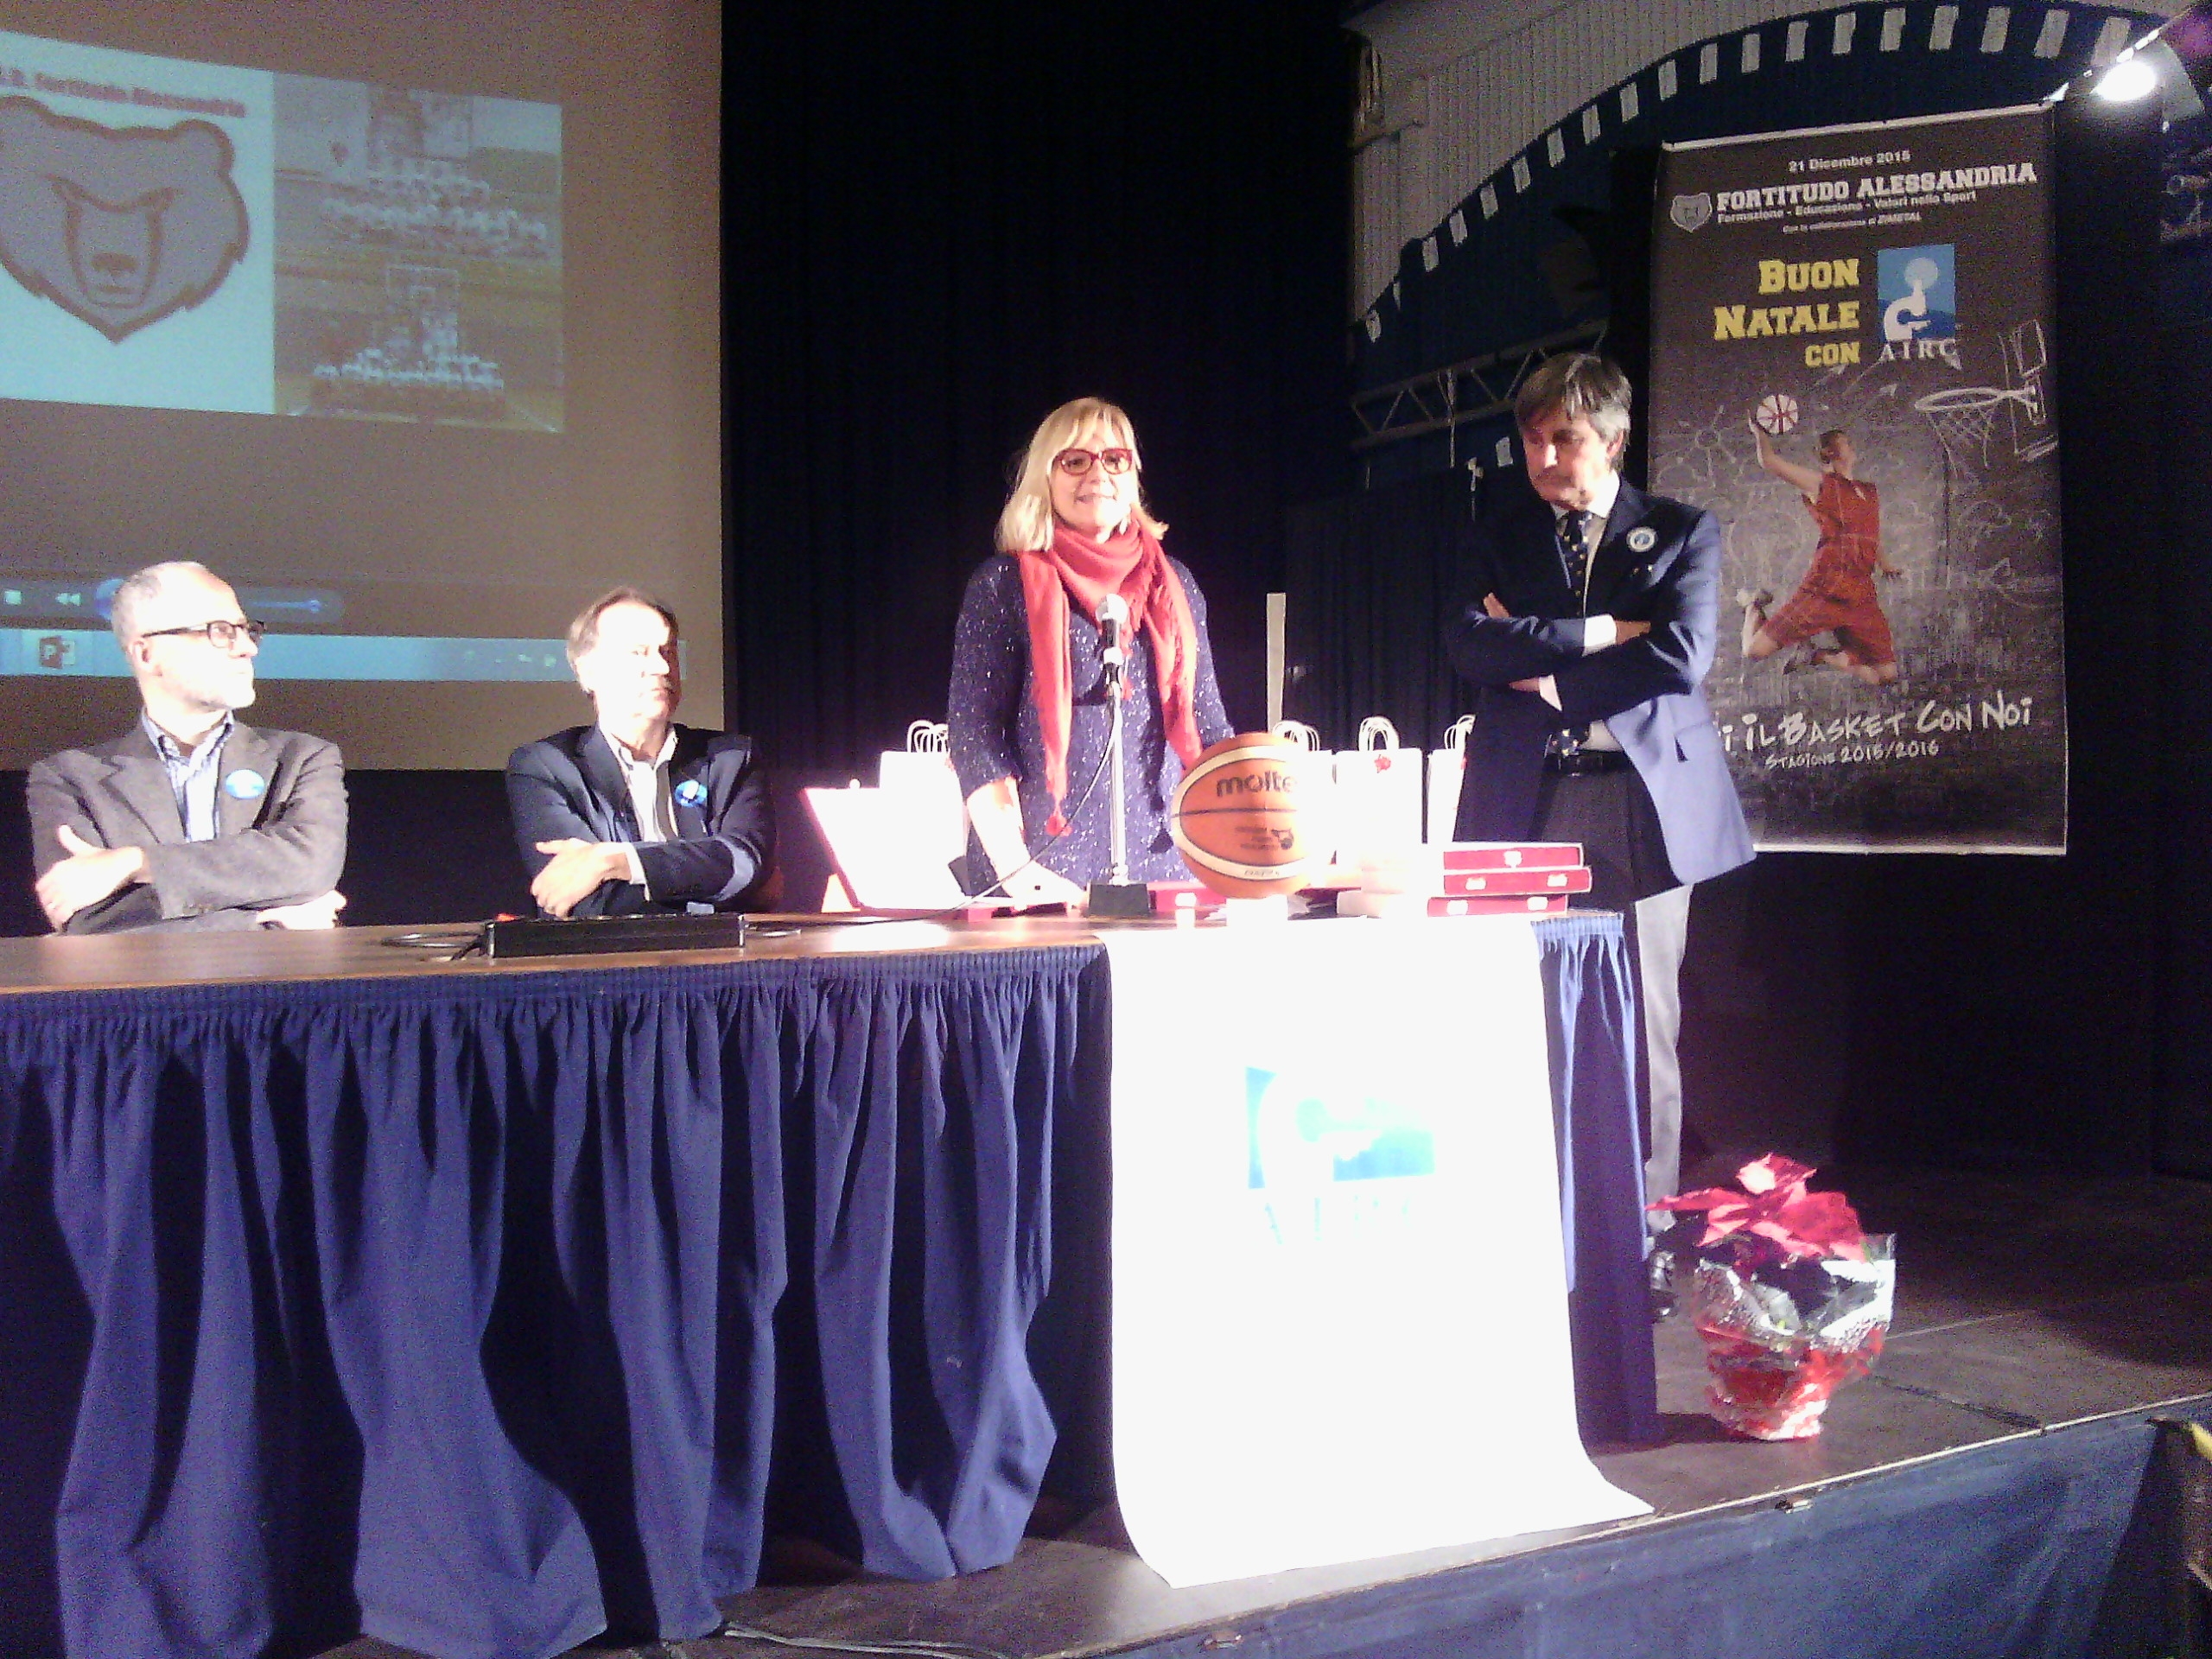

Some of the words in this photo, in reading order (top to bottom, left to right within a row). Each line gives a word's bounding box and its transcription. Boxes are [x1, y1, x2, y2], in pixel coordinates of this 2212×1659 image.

[1788, 160, 1805, 173] 21
[1808, 155, 1873, 170] Dicembre
[1716, 181, 1850, 212] FORTITUDO
[1856, 162, 2037, 199] ALESSANDRIA
[1758, 257, 1860, 296] BUON
[1713, 300, 1860, 341] NATALE
[1804, 340, 1860, 368] CON
[1878, 338, 1958, 361] AIRC
[1777, 710, 1906, 747] BASKET
[1916, 698, 1973, 734] CON
[1764, 752, 1836, 770] STAGIONE
[1840, 739, 1940, 764] 2015/2016
[1216, 770, 1297, 798] molte
